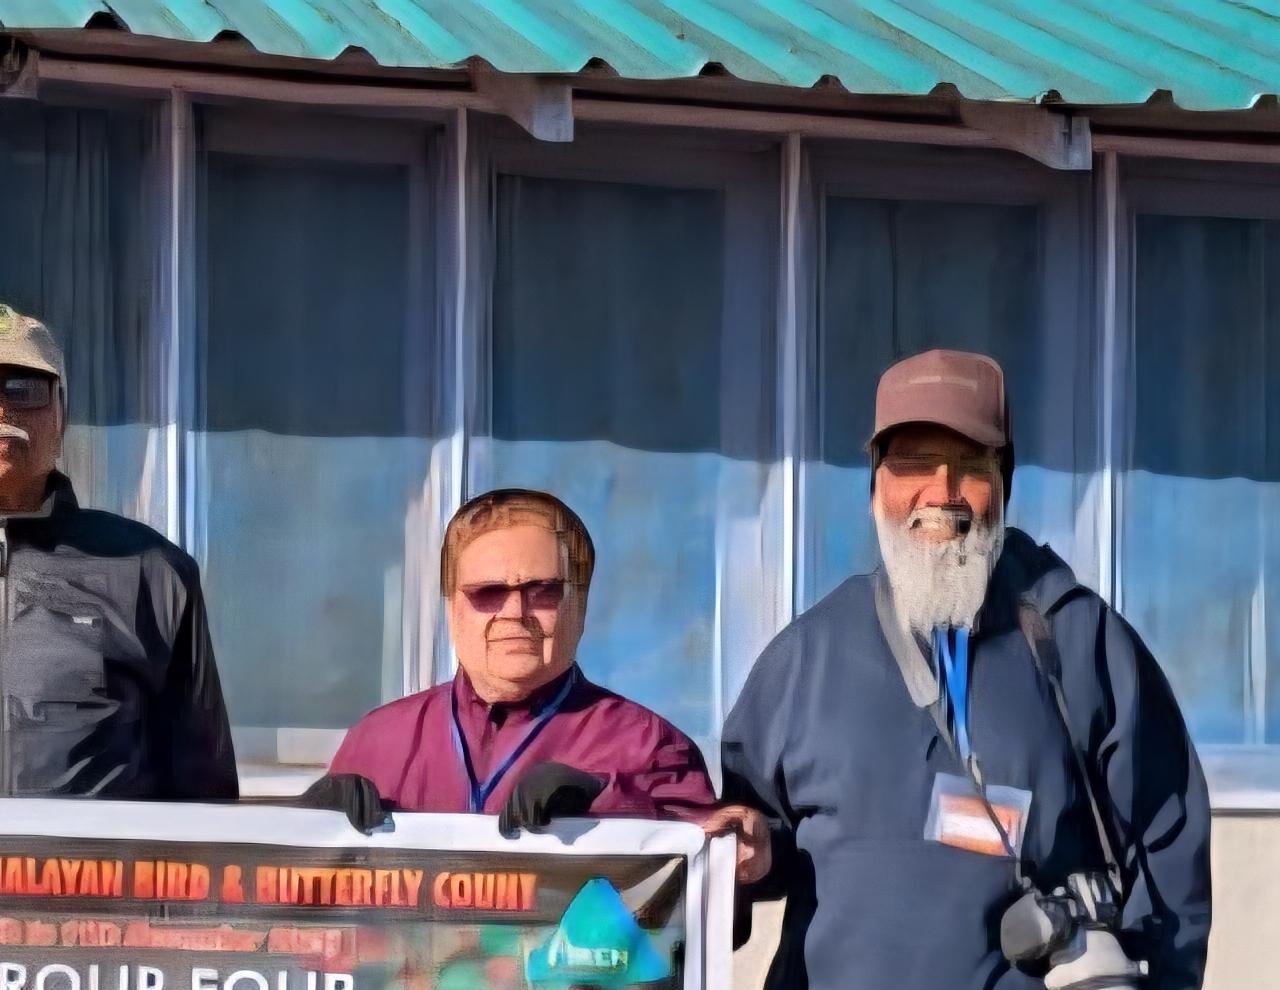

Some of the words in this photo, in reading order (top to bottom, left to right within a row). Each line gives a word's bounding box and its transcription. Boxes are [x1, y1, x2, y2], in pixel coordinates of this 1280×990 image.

[134, 860, 210, 900] BIRD
[223, 864, 244, 905] &
[256, 865, 423, 907] BUTTERFLY
[433, 871, 538, 911] COUNT
